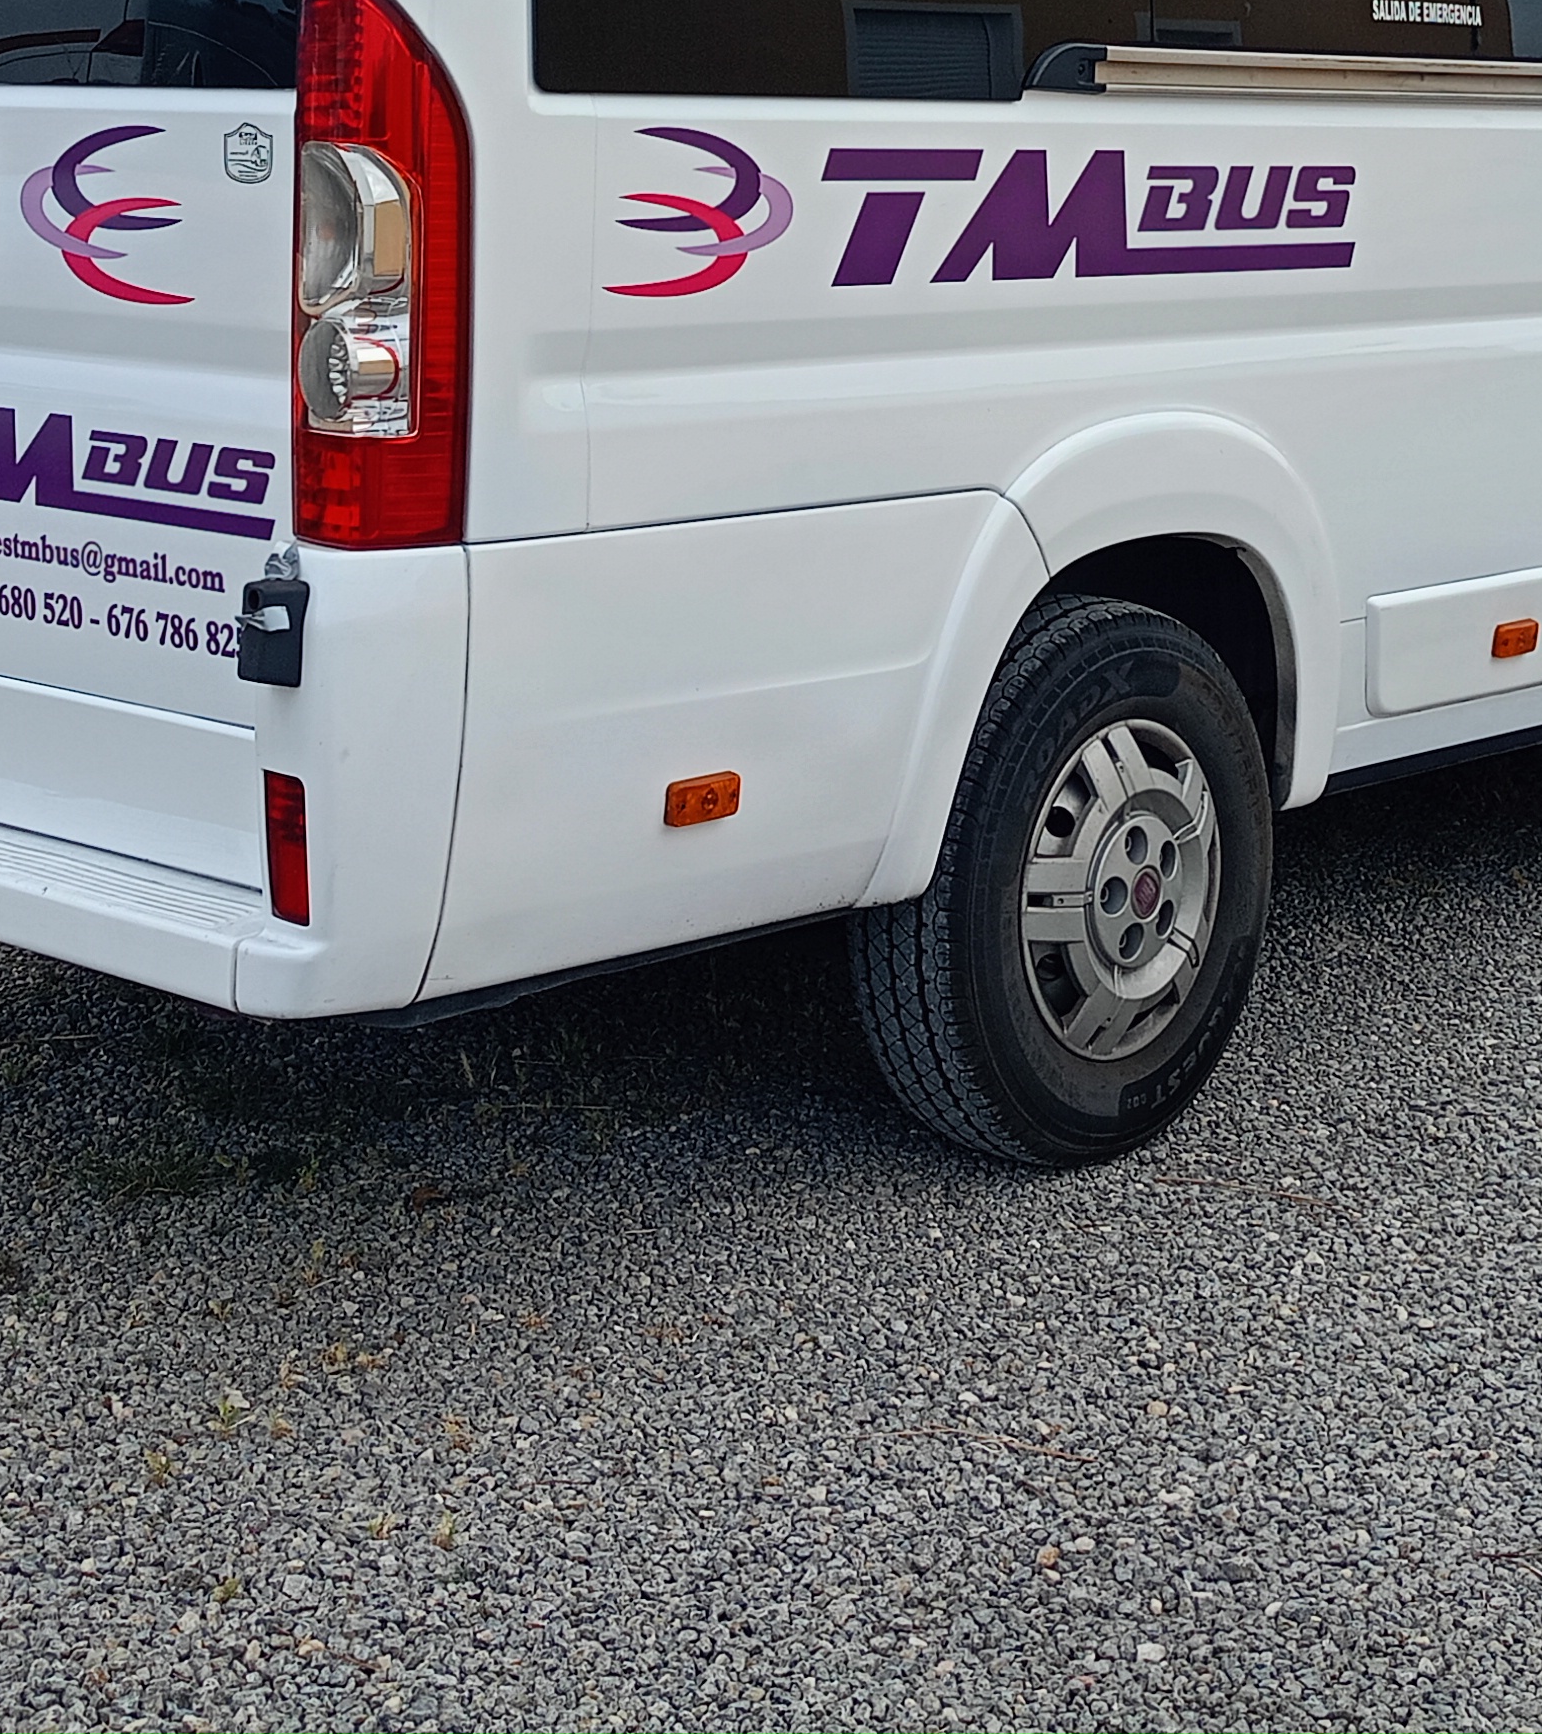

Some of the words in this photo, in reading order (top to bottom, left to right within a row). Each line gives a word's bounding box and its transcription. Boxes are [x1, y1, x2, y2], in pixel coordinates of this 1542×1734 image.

[1372, 0, 1407, 22] SALIDA
[1408, 1, 1421, 23] DE
[1423, 2, 1482, 26] EMERGENCIA
[821, 148, 1356, 286] TMBUS
[43, 592, 83, 630] 520
[107, 603, 148, 642] 676
[156, 612, 198, 652] 786
[206, 620, 240, 660] 82
